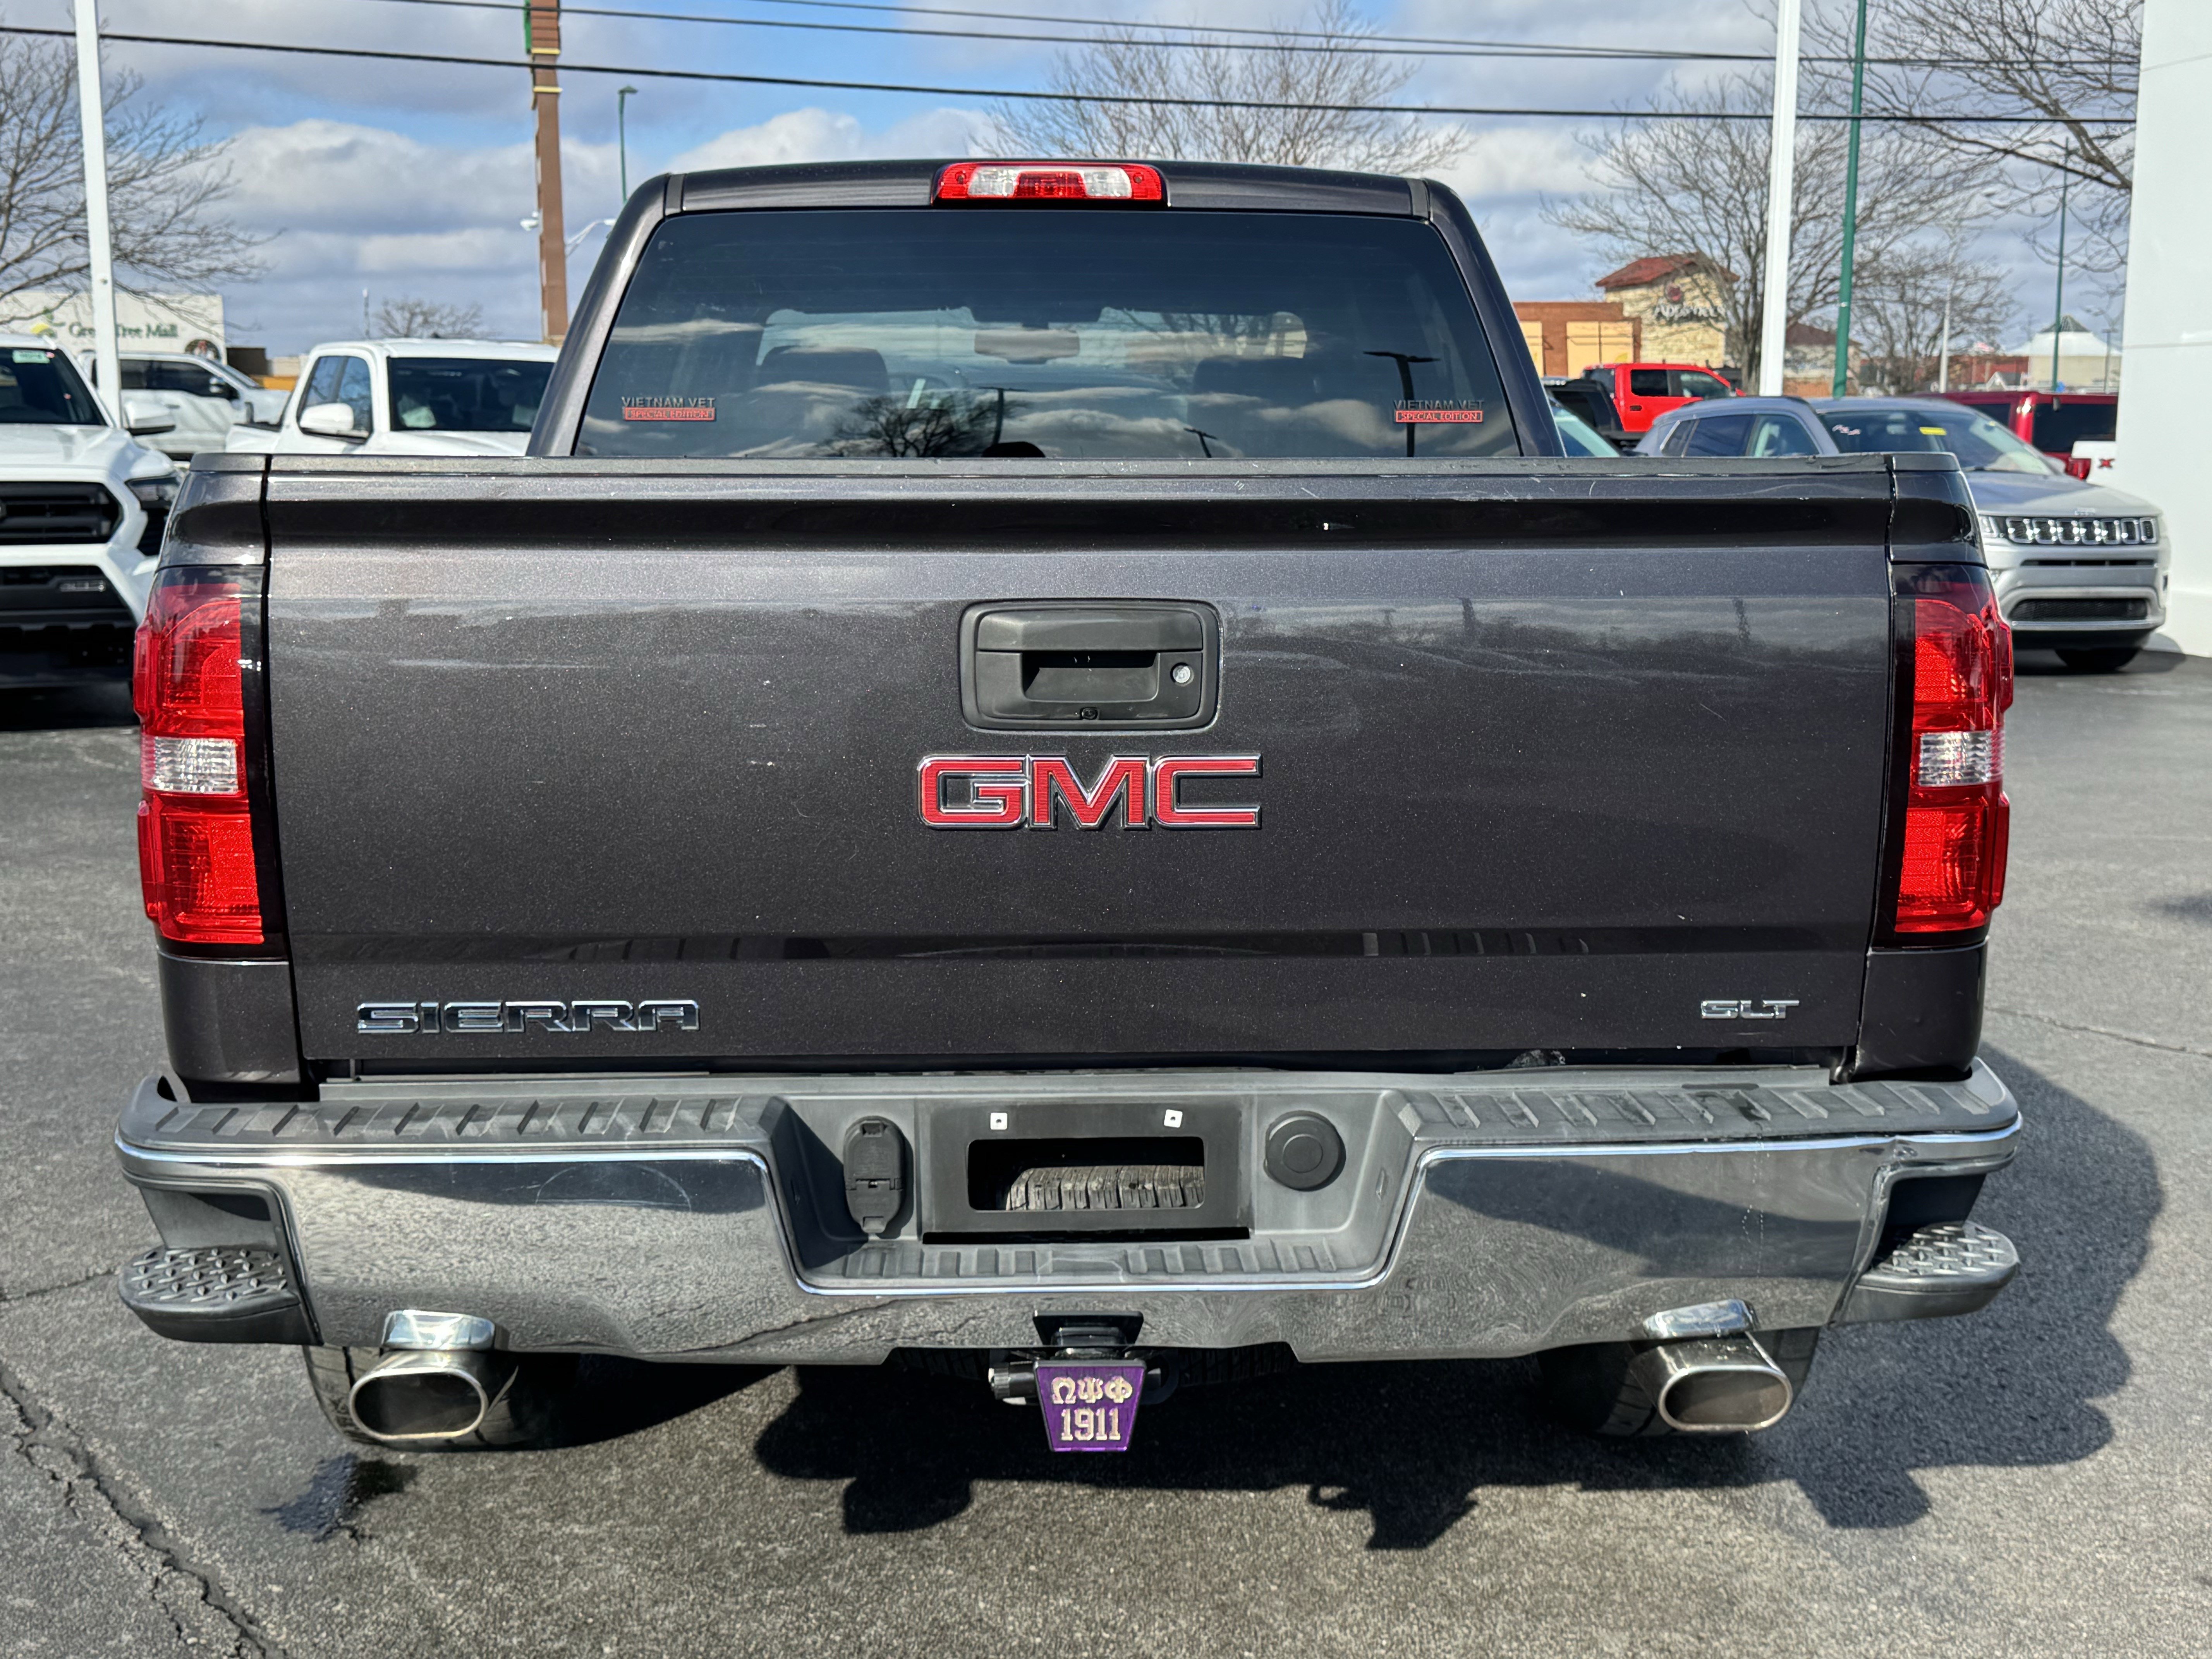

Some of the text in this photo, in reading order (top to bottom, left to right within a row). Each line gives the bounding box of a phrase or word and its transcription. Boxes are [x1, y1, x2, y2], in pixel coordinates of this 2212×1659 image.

[69, 322, 95, 337] Gre
[621, 396, 715, 407] VIETNAM VET
[1394, 400, 1484, 410] VIETNAM VET
[918, 754, 1262, 831] GMC
[357, 1000, 699, 1033] SIERRA
[1701, 1000, 1799, 1019] SLT
[1051, 1376, 1132, 1404] ΩΨΦ
[1060, 1407, 1121, 1441] 1911
